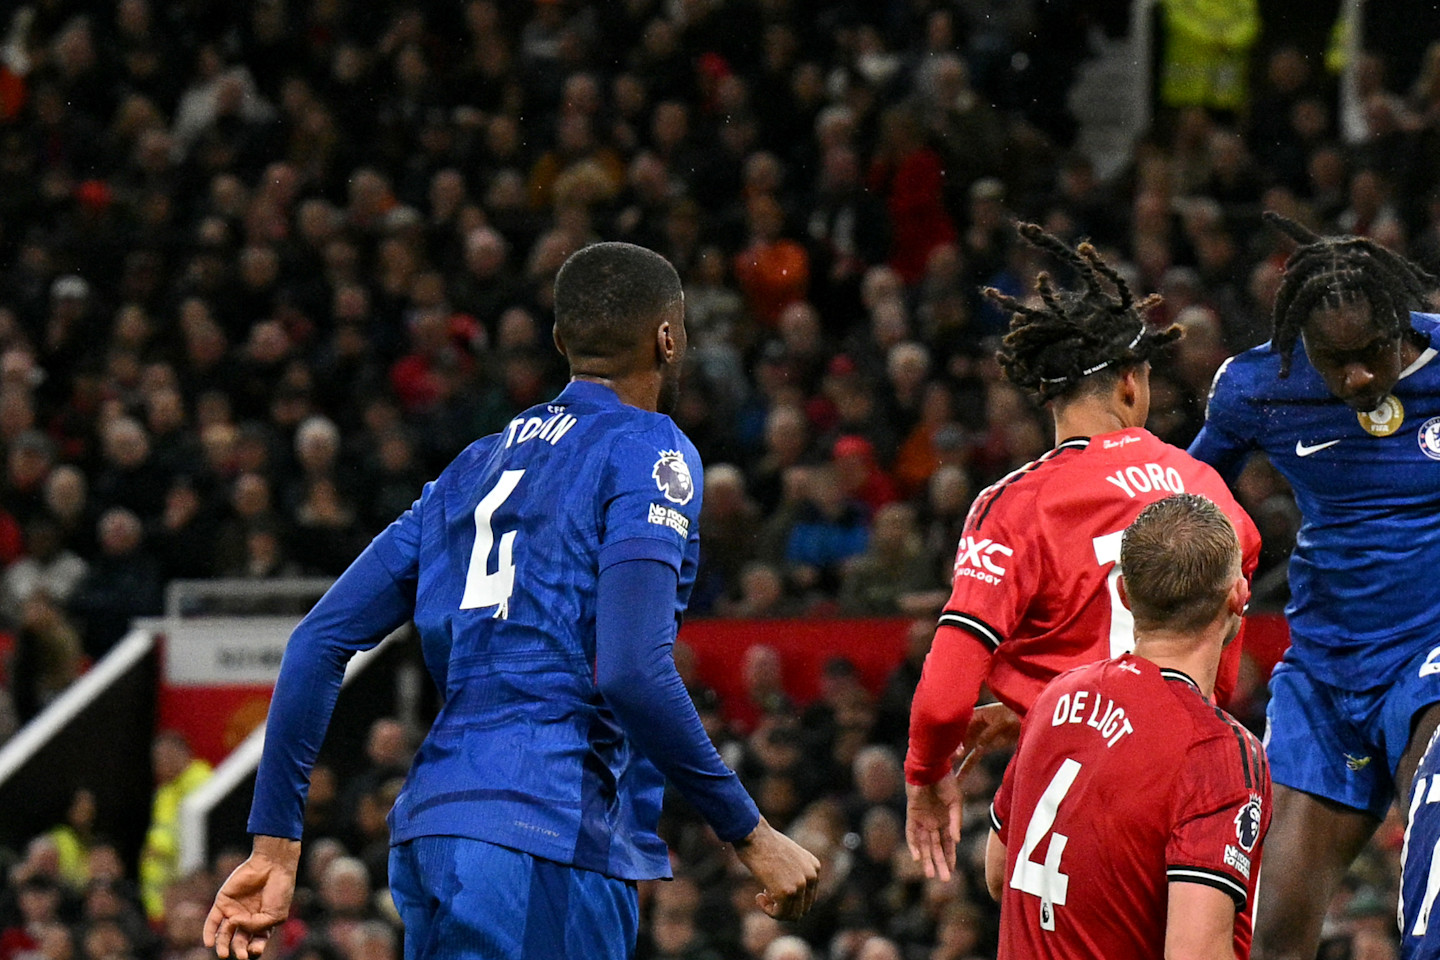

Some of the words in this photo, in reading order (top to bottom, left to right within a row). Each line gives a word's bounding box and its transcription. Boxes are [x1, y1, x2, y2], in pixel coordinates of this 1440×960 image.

[648, 502, 667, 517] No
[1105, 463, 1185, 499] YORO
[459, 469, 526, 620] 4
[1052, 691, 1089, 727] DE
[1087, 693, 1133, 748] LIGT
[1010, 758, 1082, 931] 4
